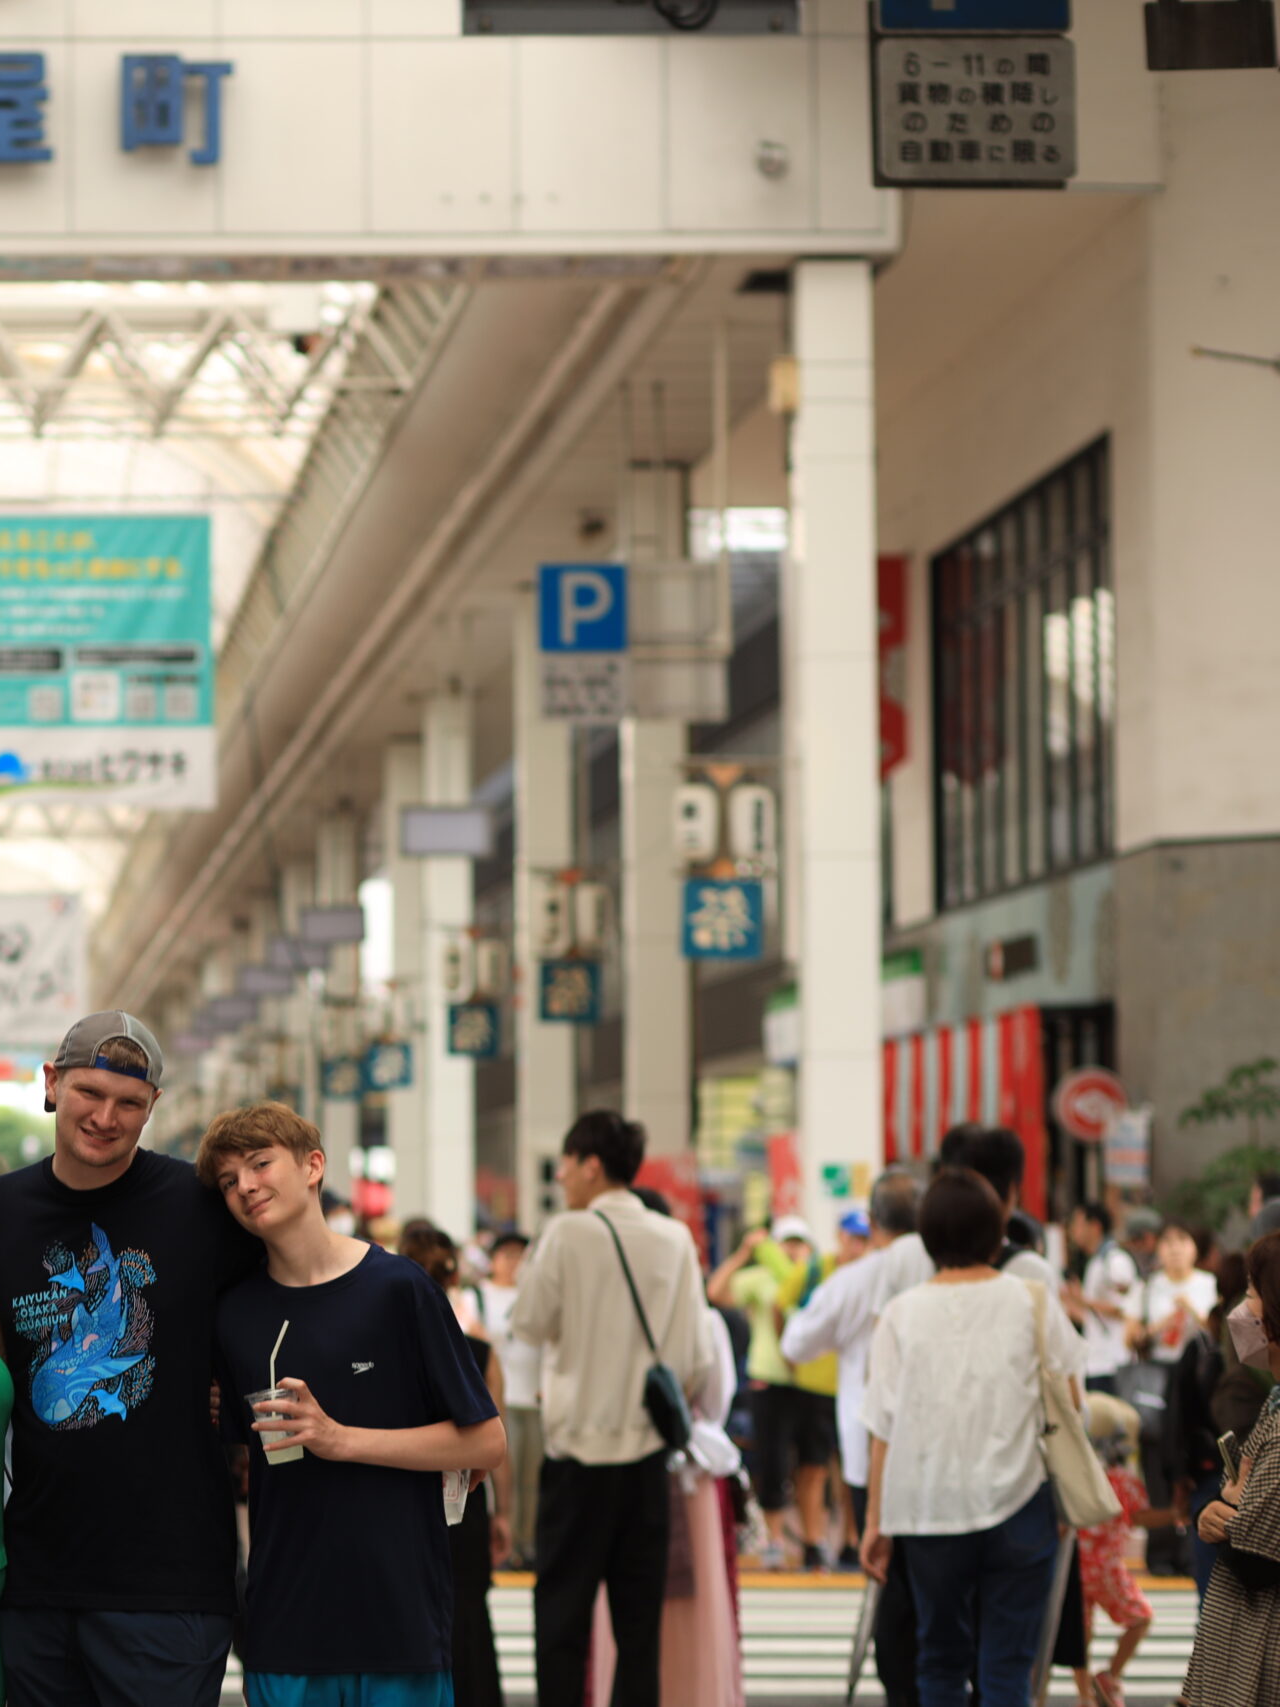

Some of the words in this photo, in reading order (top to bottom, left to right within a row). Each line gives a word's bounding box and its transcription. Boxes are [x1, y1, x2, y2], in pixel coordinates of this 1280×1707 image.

[559, 570, 613, 646] P
[12, 1288, 69, 1309] KAIYUKAN
[20, 1303, 59, 1319] OSAKA
[16, 1313, 68, 1332] AQUARIUM
